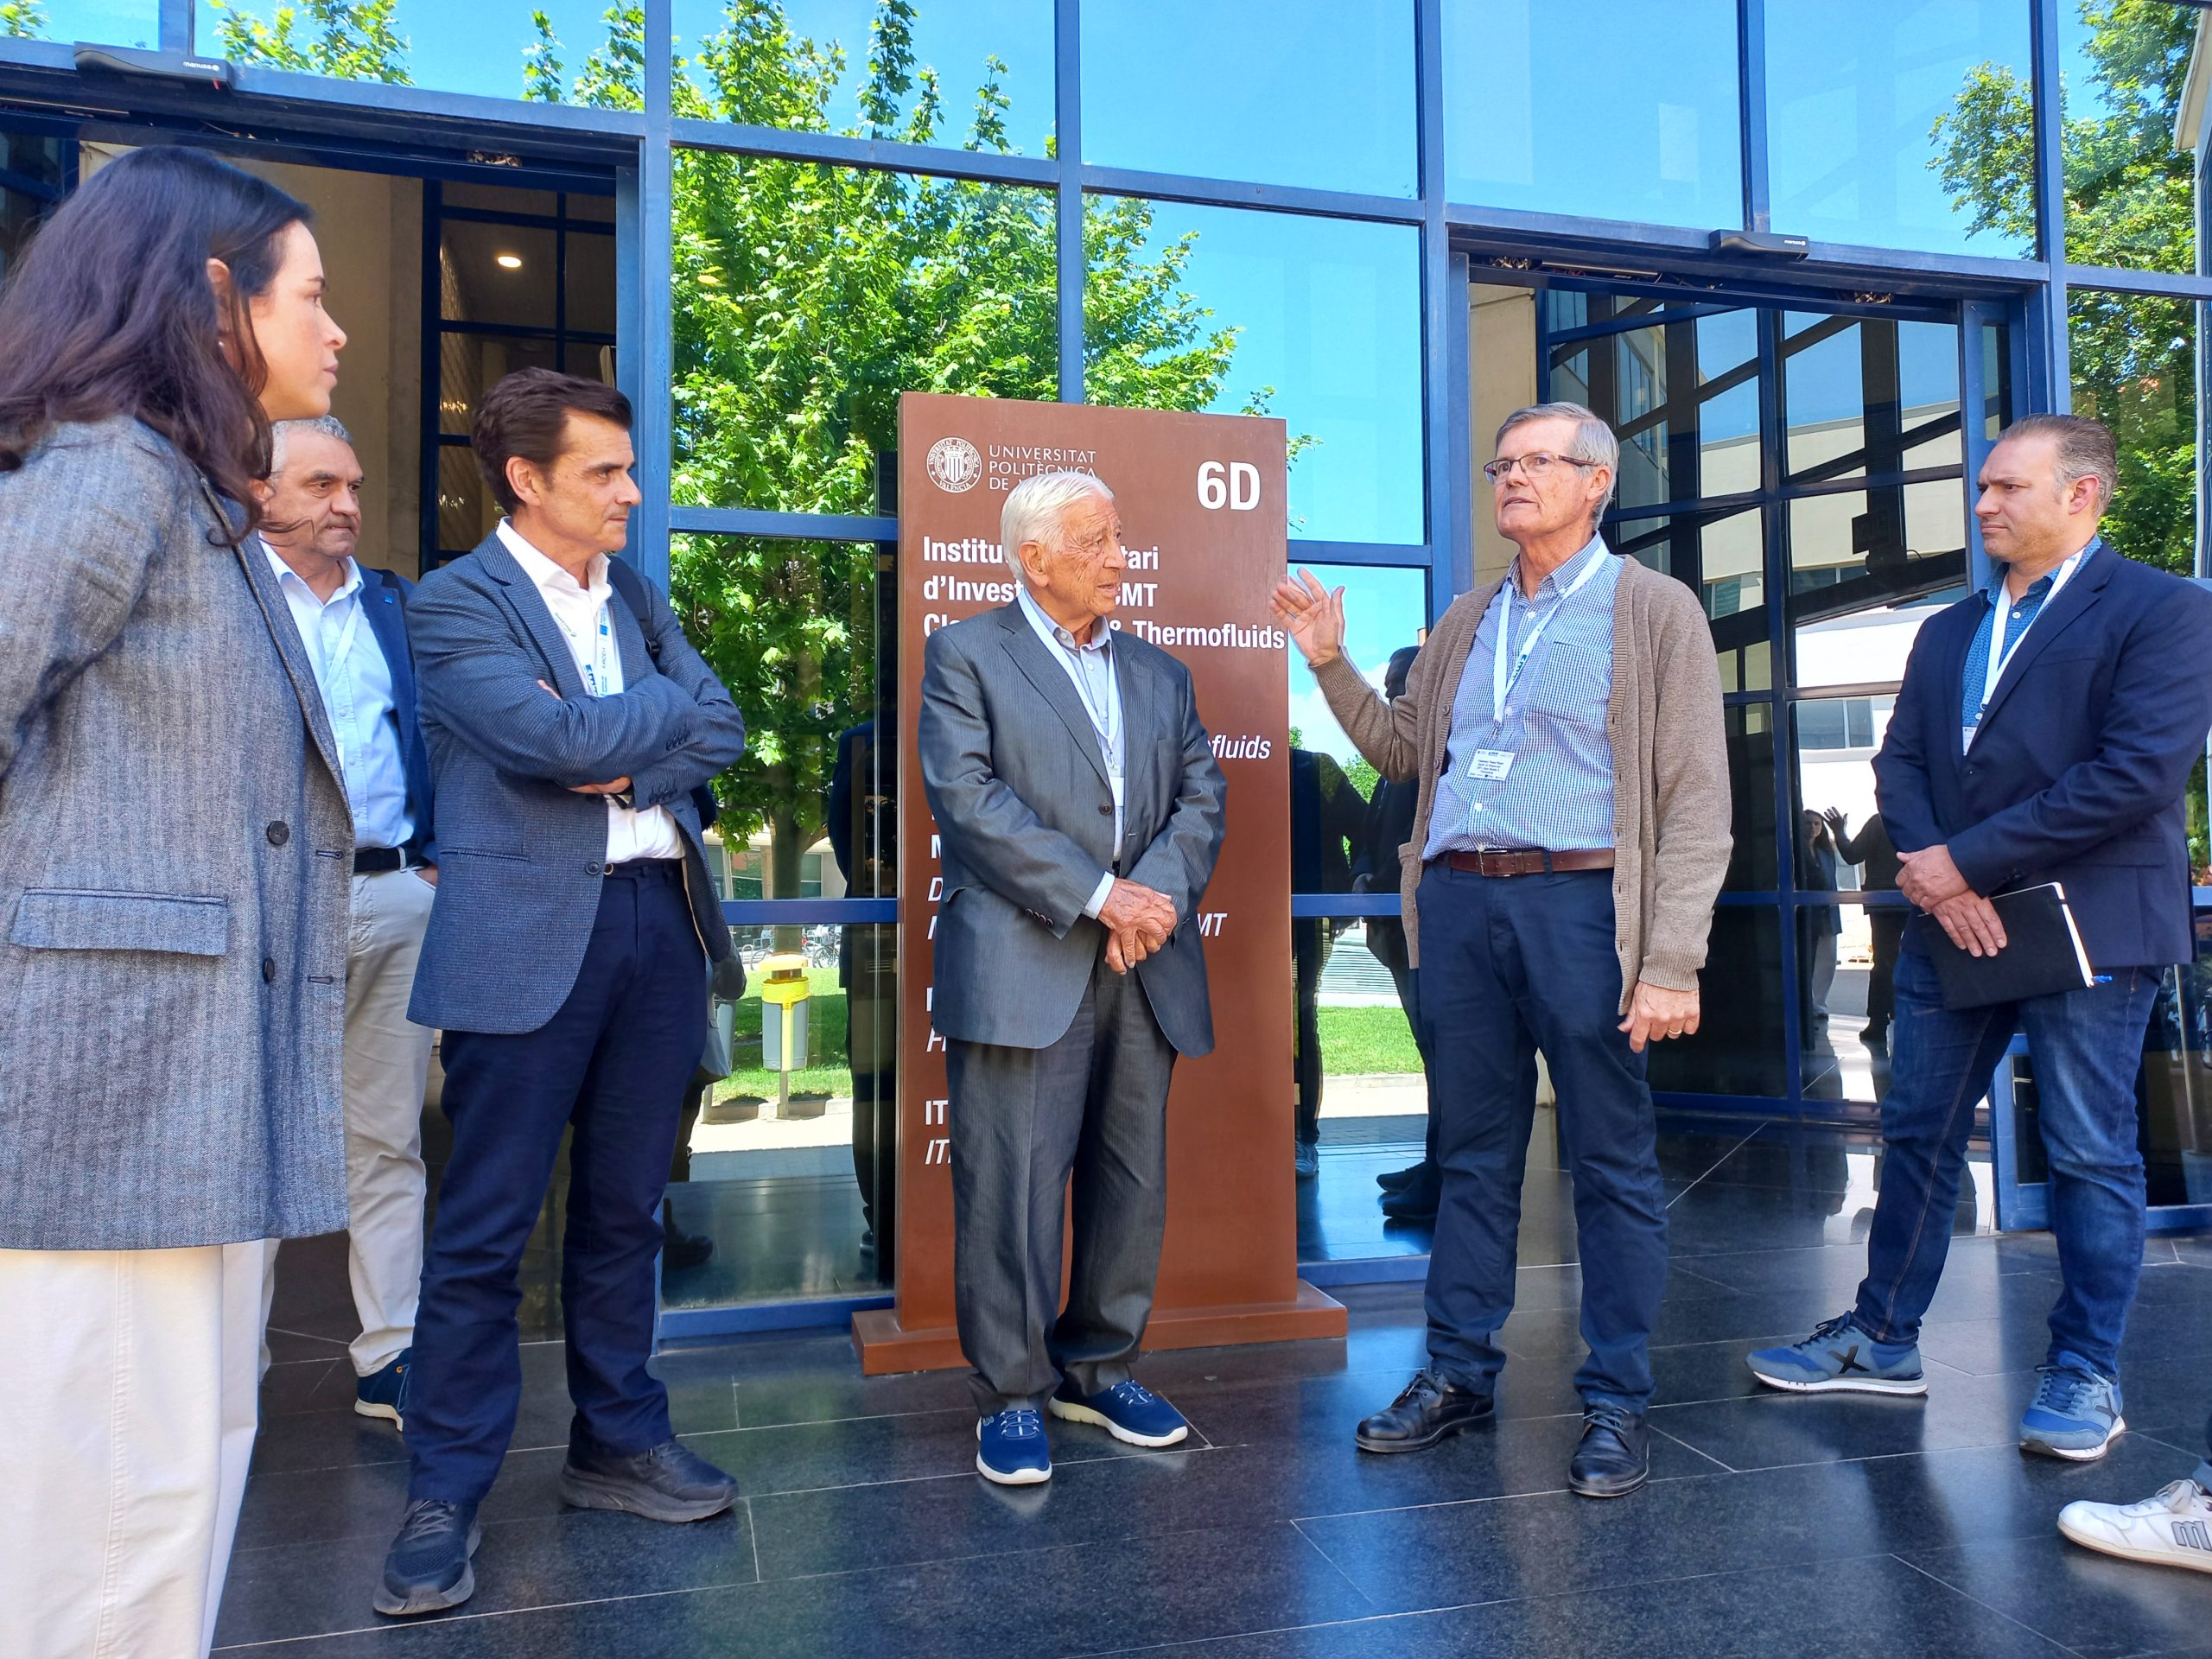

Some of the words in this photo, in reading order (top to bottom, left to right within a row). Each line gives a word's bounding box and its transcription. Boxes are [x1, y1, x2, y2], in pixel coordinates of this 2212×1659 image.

[988, 444, 1096, 463] UNIVERSITAT
[989, 477, 1009, 491] DE
[1197, 460, 1262, 511] 6D
[923, 536, 1009, 563] Institu
[923, 575, 1025, 602] d'Invest
[1132, 620, 1286, 649] Thermofluids
[1208, 734, 1272, 760] fluids
